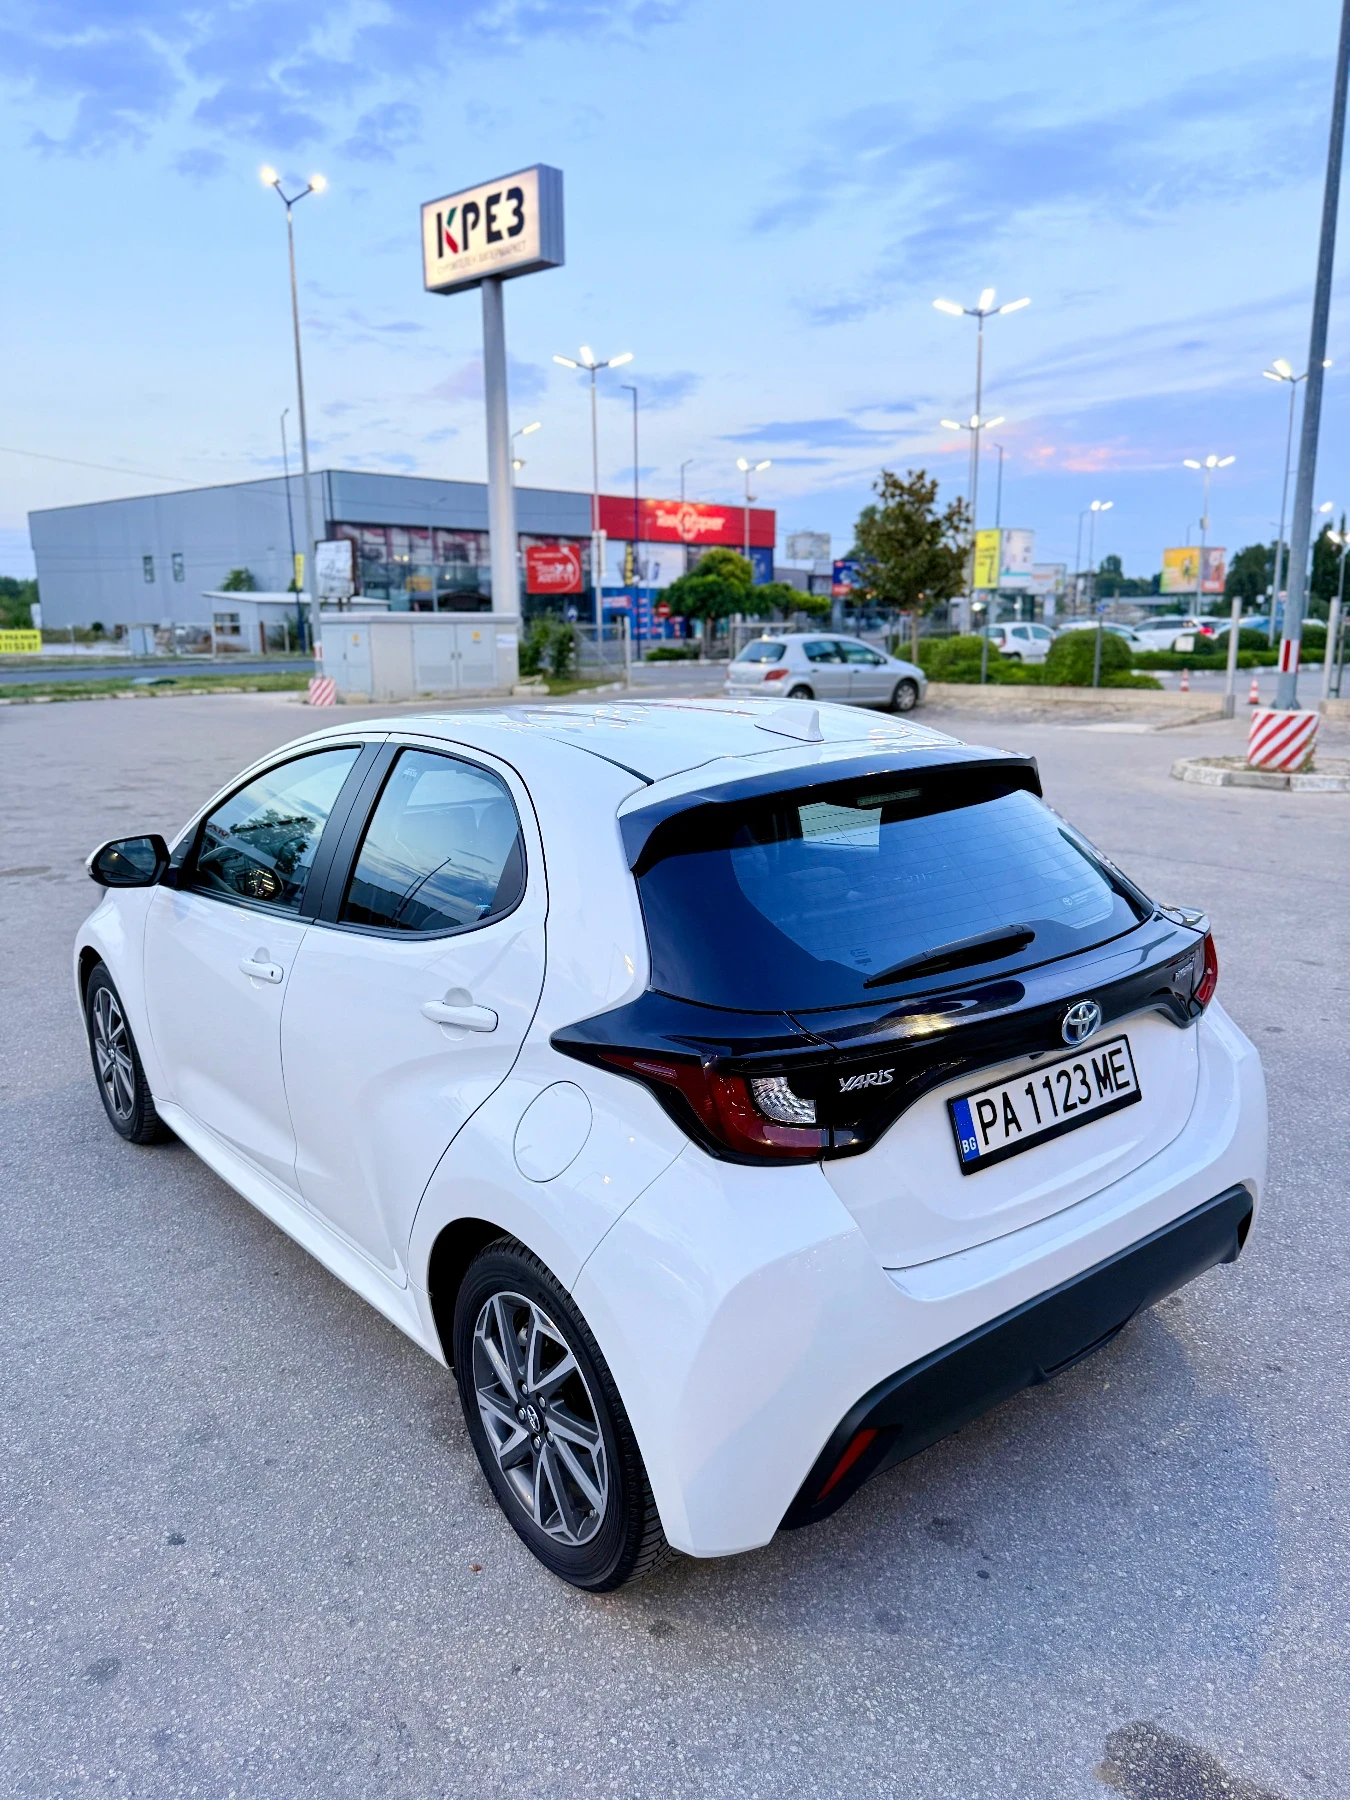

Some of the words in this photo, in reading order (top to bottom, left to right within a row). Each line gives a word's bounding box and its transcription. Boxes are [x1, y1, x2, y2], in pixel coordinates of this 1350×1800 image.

[436, 187, 525, 259] КРЕЗ
[976, 1091, 1022, 1146] PA
[1025, 1064, 1092, 1125] 1123
[1091, 1047, 1130, 1098] ME
[961, 1136, 977, 1154] BG
